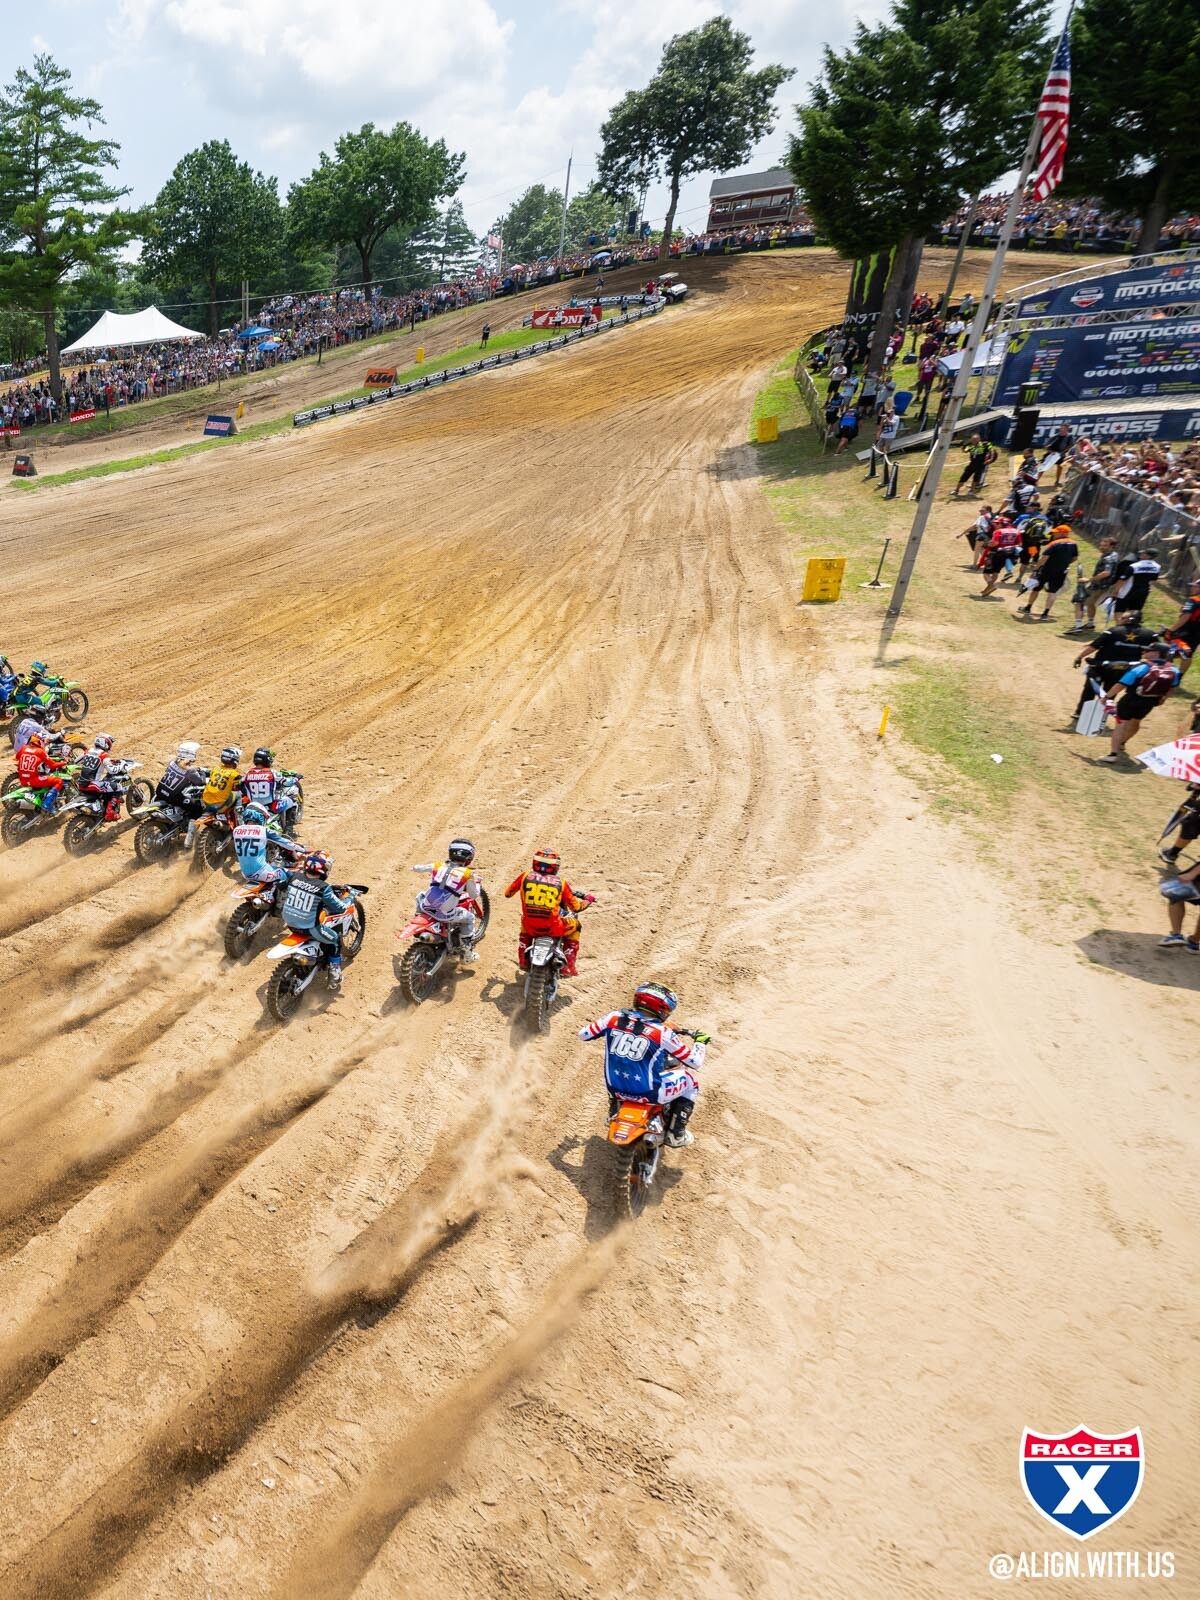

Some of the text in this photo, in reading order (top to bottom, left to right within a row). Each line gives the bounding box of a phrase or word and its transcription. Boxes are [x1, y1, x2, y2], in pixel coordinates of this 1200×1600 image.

[366, 373, 394, 383] KTM
[71, 412, 96, 423] HONDA
[20, 755, 37, 772] 152
[249, 782, 270, 798] 99
[233, 828, 261, 836] FORTIN
[234, 838, 260, 857] 375
[287, 884, 315, 912] 560
[610, 1029, 650, 1061] 769
